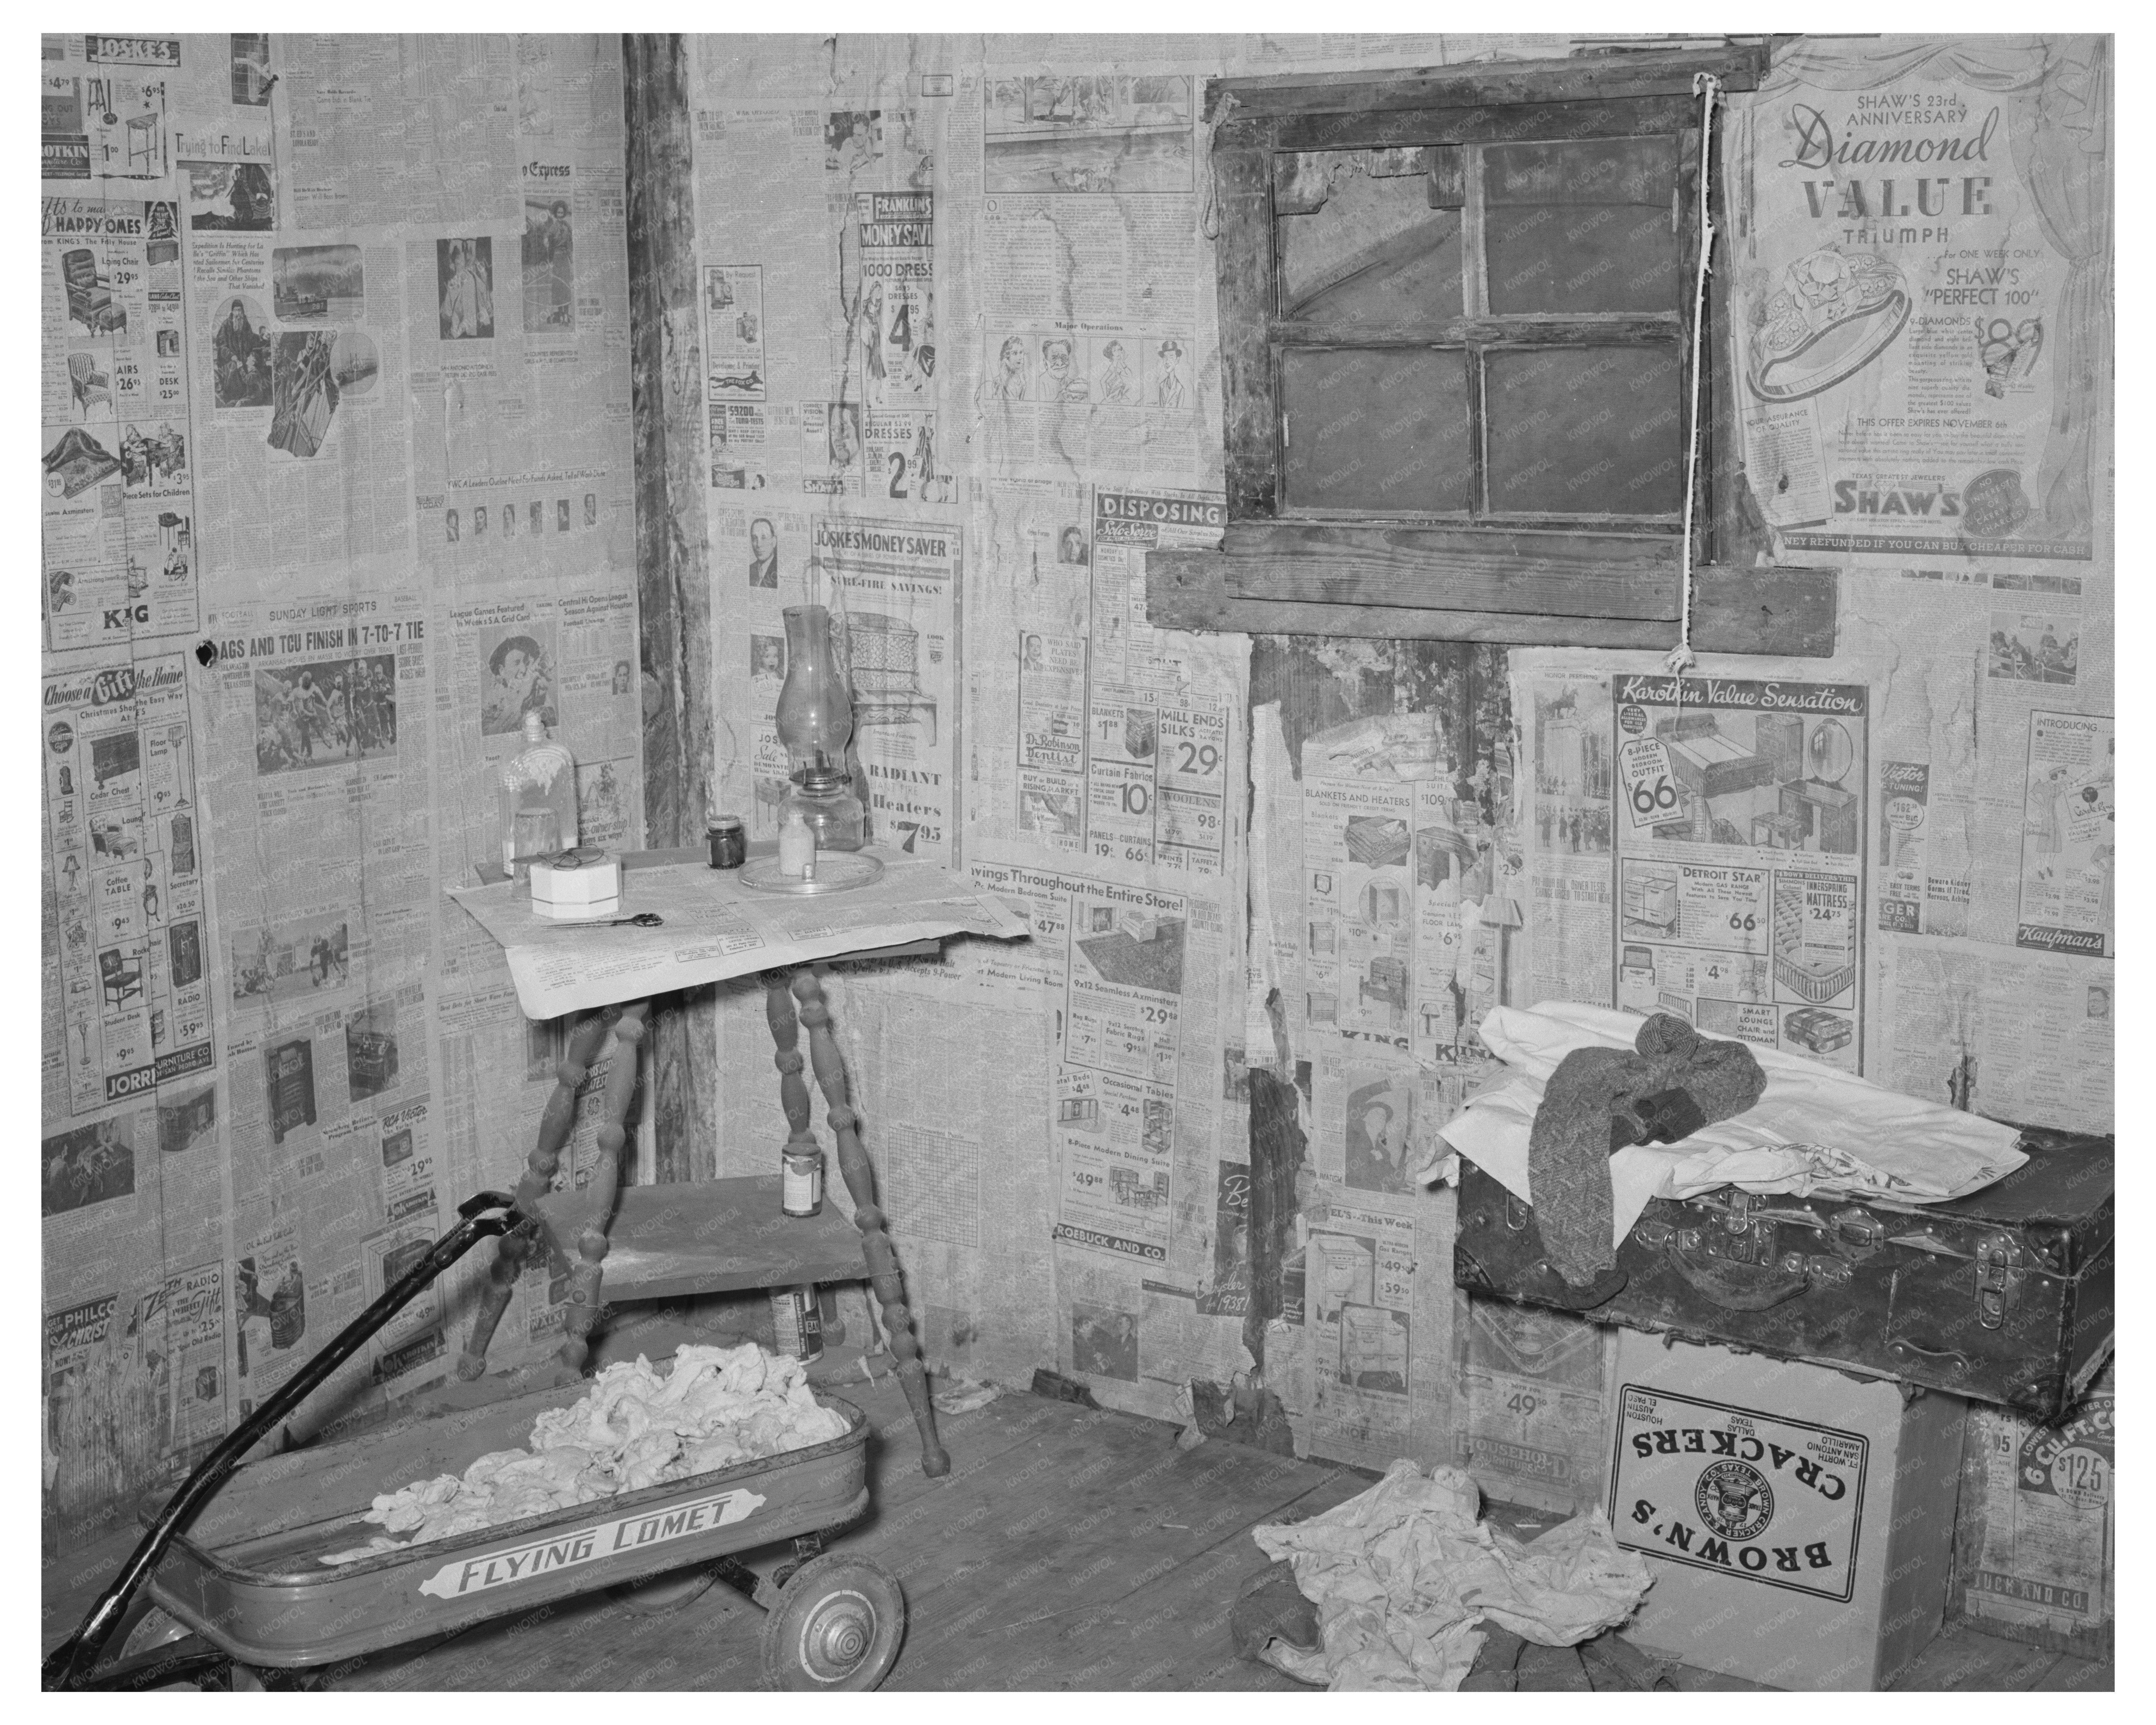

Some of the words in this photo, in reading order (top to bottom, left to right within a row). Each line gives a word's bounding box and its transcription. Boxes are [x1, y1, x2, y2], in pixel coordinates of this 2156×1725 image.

[1857, 95, 1921, 109] SHAW'S
[1928, 93, 1957, 106] 23rd
[1847, 110, 1967, 126] ANNIVERSARY
[1778, 103, 2000, 169] Diamond
[175, 133, 206, 154] Trying
[221, 135, 242, 155] Find
[530, 162, 570, 180] Express
[1801, 177, 1993, 218] VALUE
[56, 217, 103, 233] HAPPY
[861, 225, 902, 246] MONEY
[1960, 250, 1979, 258] ONE
[1984, 250, 2009, 258] WEEK
[2013, 249, 2040, 258] ONLY
[863, 264, 892, 277] 1000
[1946, 268, 2019, 285] SHAW'S
[1055, 322, 1078, 331] Major
[1081, 323, 1123, 331] Operations
[1910, 317, 1971, 326] 9-DIAMONDS
[1857, 419, 1875, 427] THIS
[1879, 419, 1905, 428] OFFER
[1908, 420, 1940, 428] EXPIRES
[1942, 420, 1992, 429] NOVEMBER
[865, 429, 912, 439] DRESSES
[163, 488, 190, 497] Children
[1835, 480, 1960, 516] SHAW'S
[1105, 498, 1220, 524] DISPOSING
[815, 530, 861, 547] JOSKE'S
[862, 534, 906, 553] MONEY
[907, 537, 946, 557] SAVER
[1810, 538, 1871, 549] REFUNDED
[1874, 540, 1885, 549] IF
[1888, 540, 1912, 550] YOU
[1914, 541, 1937, 551] CAN
[1942, 542, 1967, 551] BUY
[1970, 542, 2025, 553] CHEAPER
[2029, 544, 2051, 554] FOR
[2054, 546, 2085, 555] CASH
[269, 608, 307, 621] SUNDAY
[342, 602, 377, 614] SPORTS
[250, 637, 275, 657] AND
[278, 635, 302, 653] TCU
[306, 630, 344, 650] FINISH
[348, 628, 357, 647] IN
[363, 623, 402, 645] 7-TO-7
[406, 621, 424, 639] TIE
[45, 685, 82, 706] Choose
[95, 670, 133, 703] Gift
[136, 669, 152, 690] the
[153, 667, 183, 687] Home
[1622, 677, 1704, 704] Karotkin
[1707, 682, 1758, 706] Value
[1760, 684, 1862, 712] Sensation
[1091, 708, 1124, 718] BLANKETS
[1161, 710, 1189, 724] MILL
[1193, 714, 1223, 728] ENDS
[1161, 724, 1195, 738] SILKS
[151, 748, 167, 757] Lamp
[1633, 753, 1658, 761] MODERN
[1632, 759, 1662, 768] BEDROOM
[870, 765, 941, 785] RADIANT
[1091, 764, 1120, 777] Curtain
[1124, 768, 1153, 782] Fabrics
[1631, 766, 1664, 778] OUTFIT
[91, 789, 110, 800] Cedar
[112, 786, 130, 797] Chest
[1306, 790, 1347, 801] BLANKETS
[1349, 793, 1369, 803] AND
[1371, 795, 1410, 807] HEATERS
[873, 794, 941, 817] Heaters
[106, 876, 128, 886] Coffee
[170, 878, 198, 890] Secretary
[1807, 882, 1847, 893] INNERSPRING
[105, 884, 131, 896] TABLE
[1011, 869, 1084, 893] Throughout
[1087, 884, 1104, 895] the
[1107, 888, 1142, 904] Entire
[1145, 894, 1183, 911] Store!
[1807, 895, 1847, 908] MATTRESS
[2019, 927, 2101, 948] Kaufman's
[1095, 983, 1130, 996] Seamless
[178, 994, 200, 1005] RADIO
[1742, 1008, 1770, 1016] SMART
[1739, 1017, 1773, 1025] LOUNGE
[1738, 1035, 1775, 1043] OTTOMAN
[1103, 1077, 1142, 1092] Occasional
[1147, 1087, 1174, 1099] Tables
[1058, 1226, 1108, 1247] ROEBUCK
[1113, 1240, 1140, 1253] AND
[1145, 1247, 1165, 1260] CO.
[187, 1274, 220, 1291] RADIO
[1627, 1403, 1654, 1414] AUSTIN
[1627, 1411, 1662, 1425] HOUSTON
[1731, 1416, 1753, 1427] TEXAS
[1727, 1424, 1755, 1436] DALLAS
[2023, 1425, 2050, 1457] LOWEST
[2076, 1401, 2095, 1414] EVER
[1807, 1441, 1839, 1456] ANTONIO
[1822, 1436, 1860, 1450] AMARILLO
[1818, 1454, 1845, 1466] WORTH
[1841, 1449, 1860, 1460] SAN
[1632, 1429, 1846, 1501] CRACKERS
[1632, 1499, 1832, 1572] BROWN'S
[458, 1530, 597, 1593] FLYING
[613, 1494, 733, 1551] COMET
